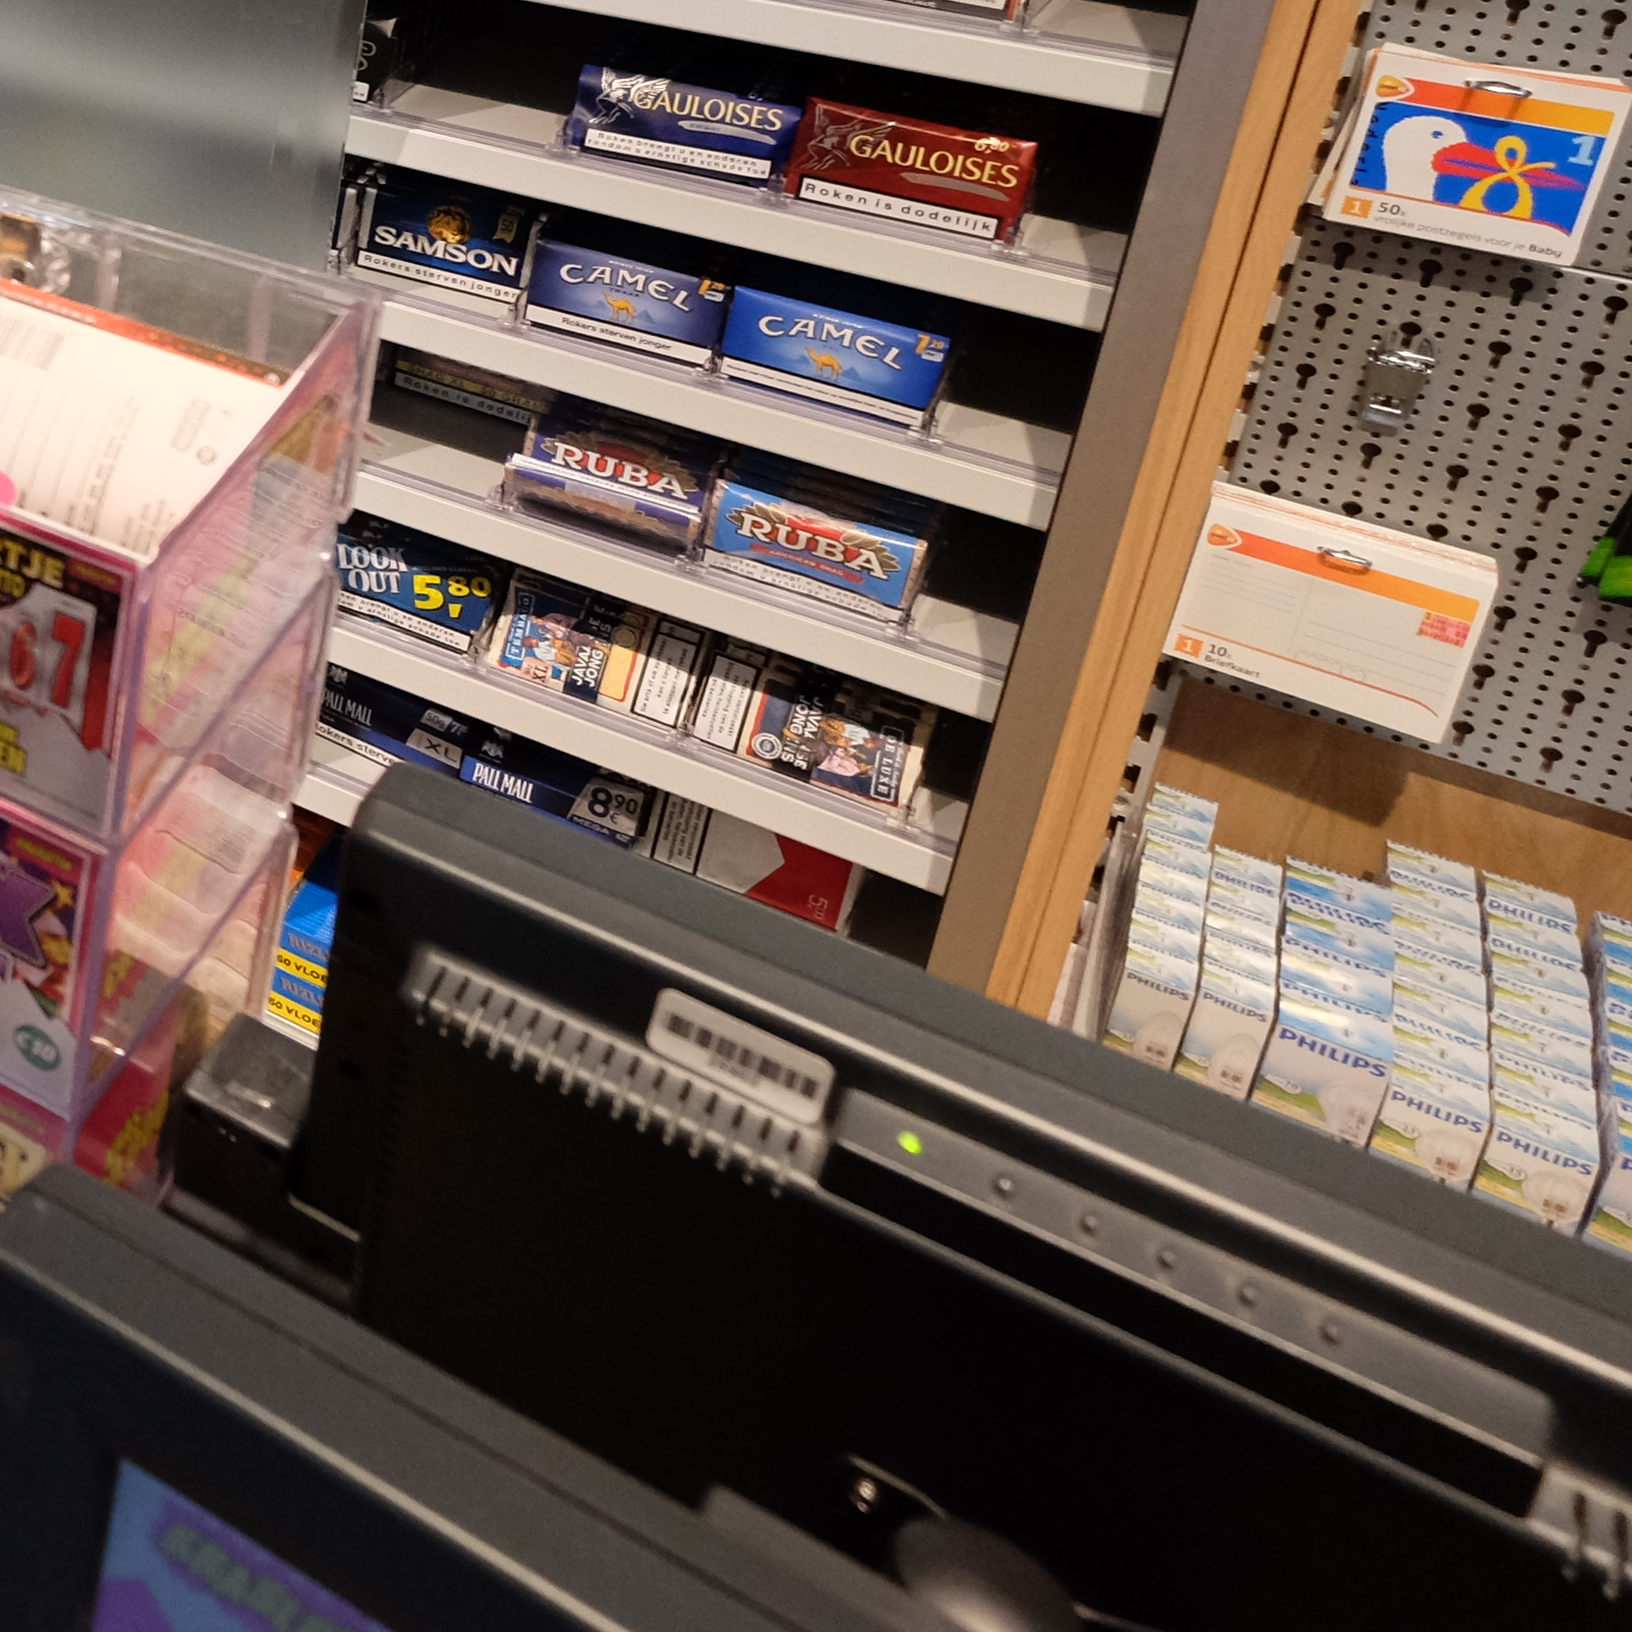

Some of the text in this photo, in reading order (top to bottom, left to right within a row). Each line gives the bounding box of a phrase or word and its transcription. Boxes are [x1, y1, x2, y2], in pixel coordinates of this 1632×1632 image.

[633, 88, 784, 131] GAULOISES
[849, 135, 1020, 188] GAULOISES
[1568, 136, 1597, 166] 1
[804, 183, 992, 232] Roken is dodelijk
[1350, 200, 1362, 214] 1
[374, 225, 519, 277] SAMSON
[1417, 222, 1483, 243] postzegels
[1485, 236, 1512, 250] voor
[1514, 241, 1526, 253] je
[1529, 243, 1562, 258] Baby
[364, 254, 517, 299] Rokers sterven jonger
[560, 263, 693, 312] CAMEL
[562, 317, 673, 351] Rokers sterven jonger
[758, 315, 903, 371] CAMEL
[403, 375, 449, 399] Roken
[551, 441, 688, 500] RUBA
[337, 544, 408, 572] LOOK
[737, 512, 889, 580] RUBA
[348, 569, 400, 593] OUT
[10, 622, 36, 690] 6
[51, 611, 85, 708] 7
[346, 696, 372, 727] MALL
[424, 736, 460, 763] XL
[472, 762, 534, 804] PALL MALL
[877, 757, 894, 796] LUXE
[1487, 898, 1576, 935] PHILIPS
[1127, 971, 1190, 1002] PHILIPS
[1203, 991, 1267, 1023] PHILIPS
[1279, 1026, 1387, 1079] PHILIPS
[1390, 1089, 1484, 1134] PHILIPS
[1496, 1130, 1594, 1176] PHILIPS
